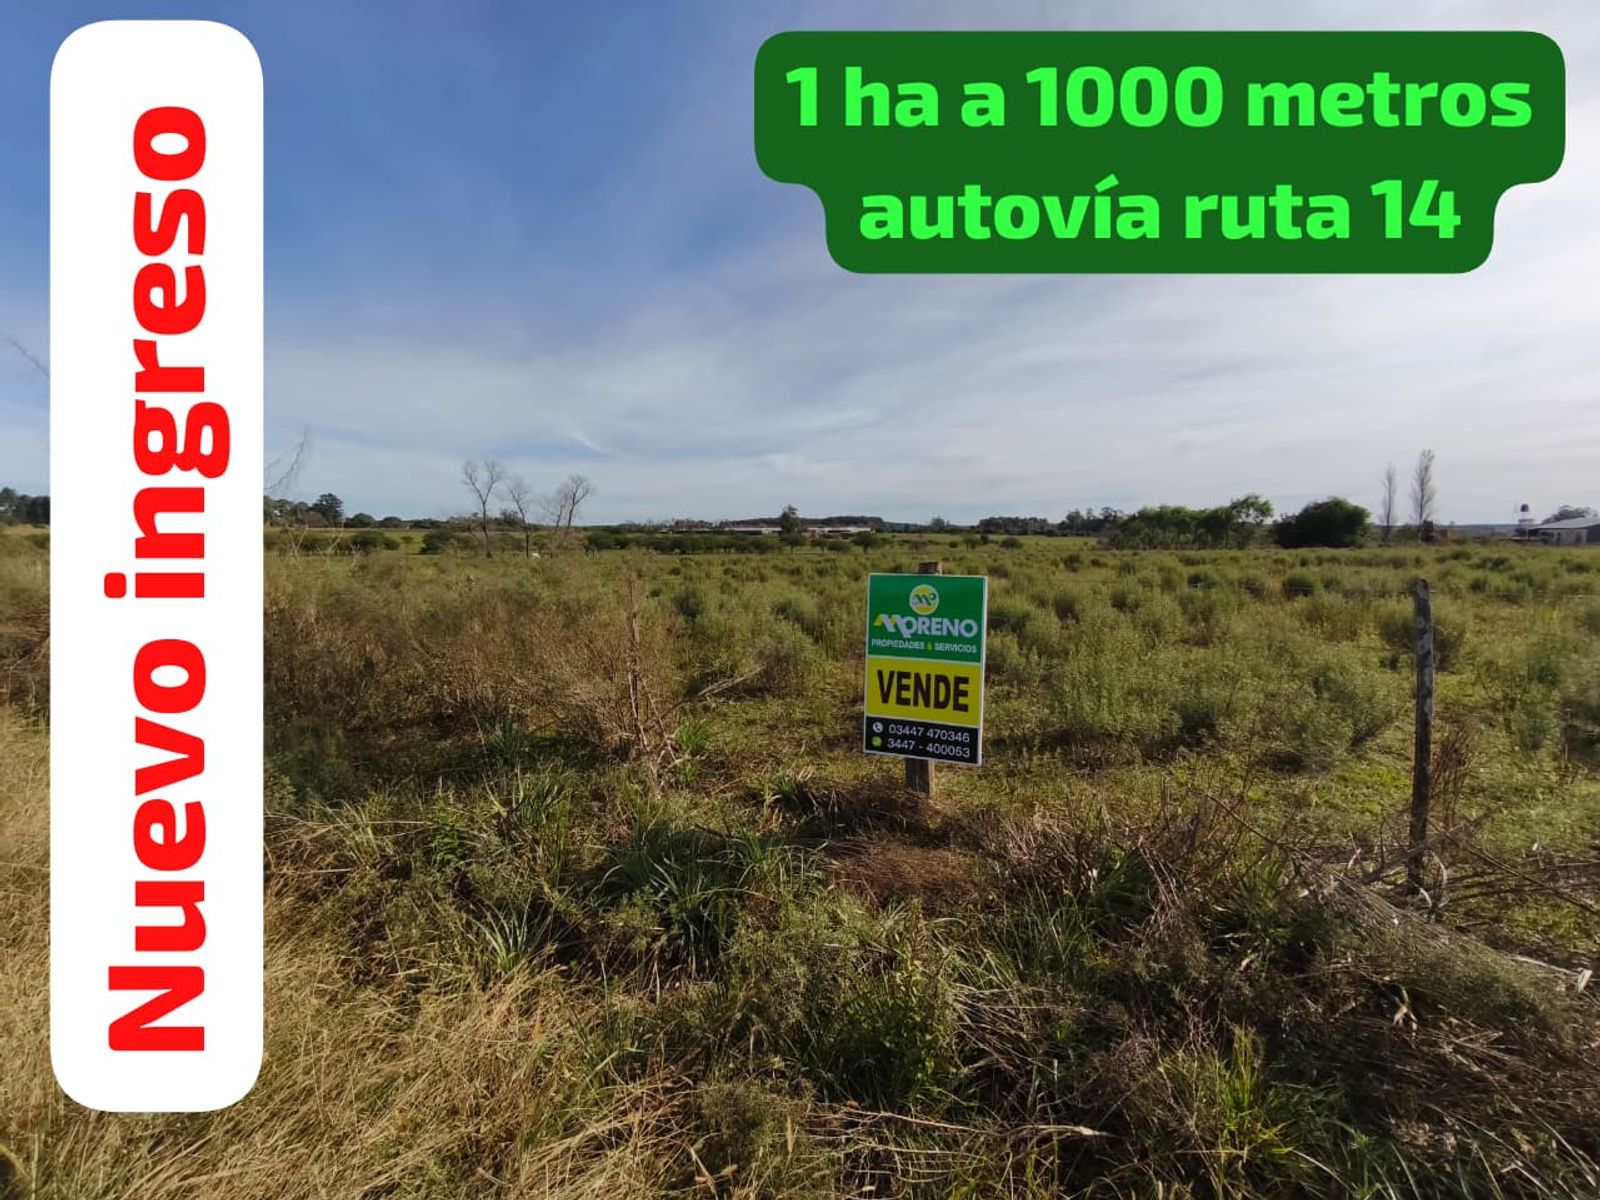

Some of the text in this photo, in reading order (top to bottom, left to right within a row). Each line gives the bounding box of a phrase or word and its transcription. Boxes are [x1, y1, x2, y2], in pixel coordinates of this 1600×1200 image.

[873, 613, 979, 638] MORENO
[871, 638, 925, 650] PROPIEDADES
[934, 642, 978, 654] SERVICIOS
[877, 669, 970, 713] VENDE
[888, 723, 924, 737] 03447
[887, 738, 916, 751] 3447
[926, 742, 970, 758] 400053
